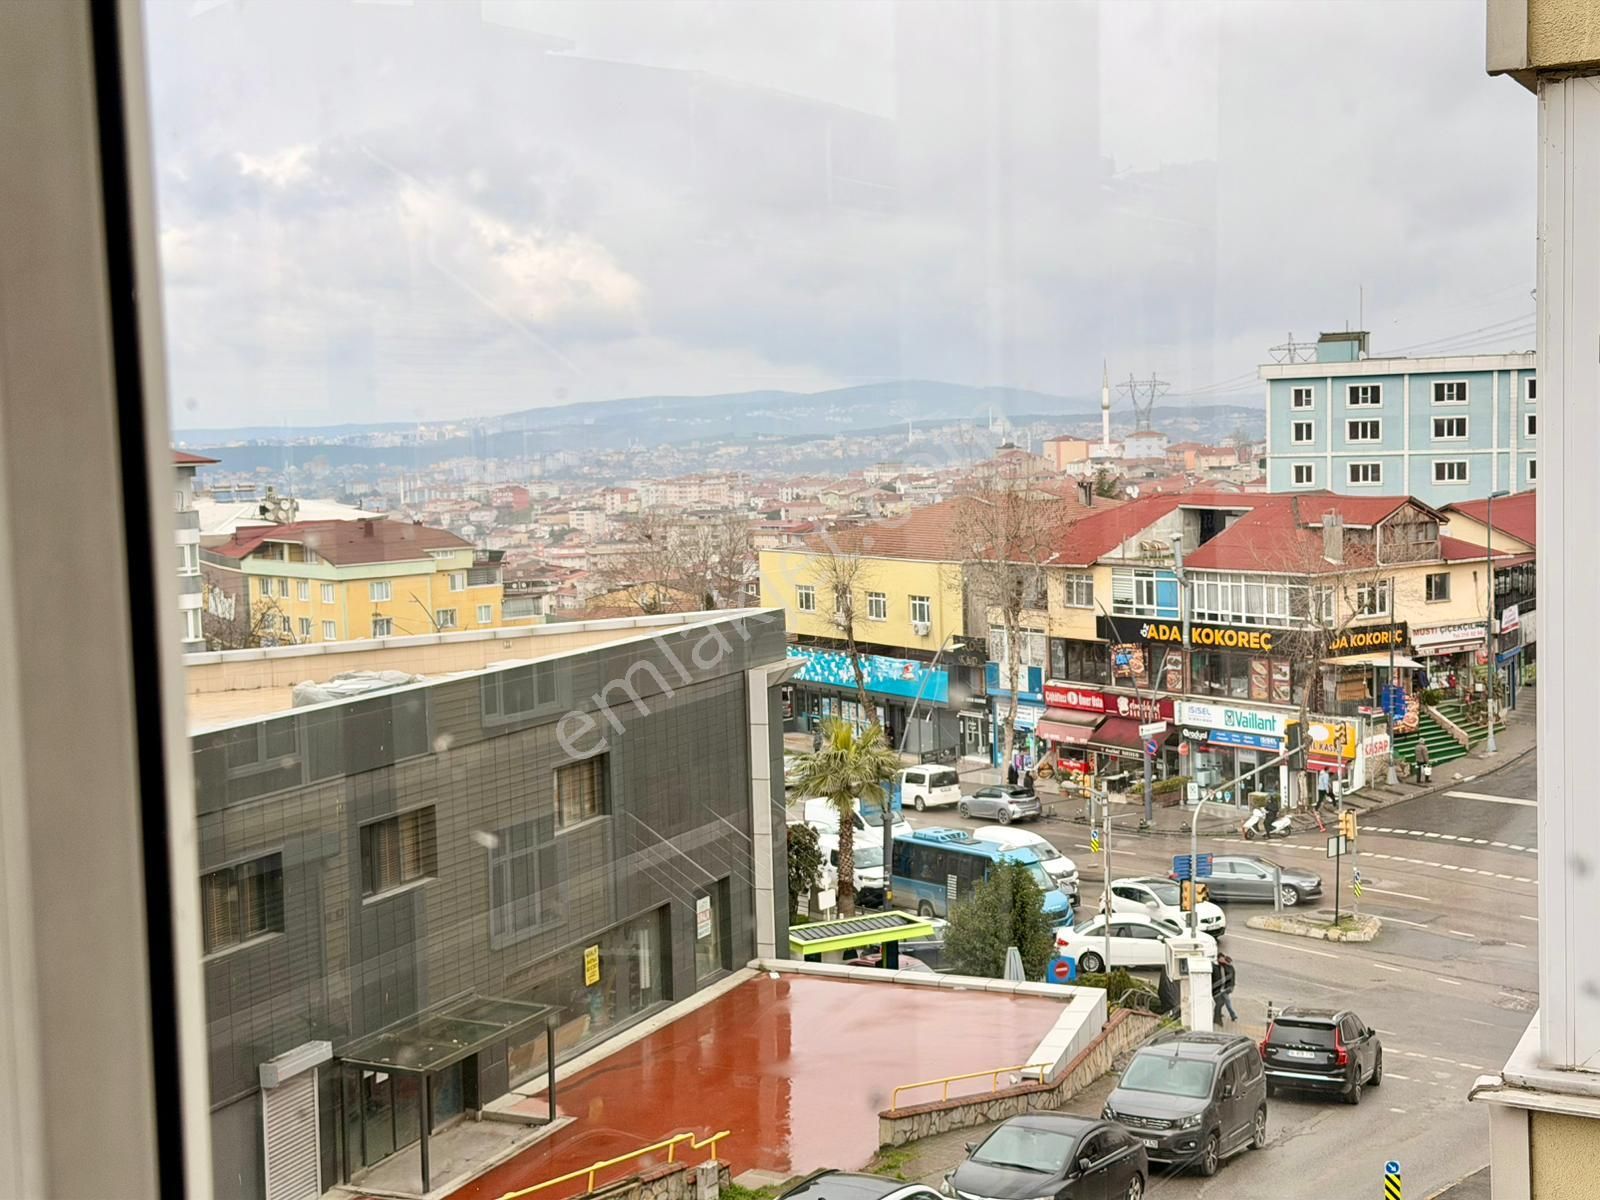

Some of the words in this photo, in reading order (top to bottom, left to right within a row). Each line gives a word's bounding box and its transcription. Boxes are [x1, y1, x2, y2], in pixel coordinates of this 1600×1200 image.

[1147, 623, 1182, 642] ADA
[1191, 627, 1273, 651] KOKOREÇ
[1329, 635, 1348, 650] DA
[1235, 710, 1277, 732] Vaillant
